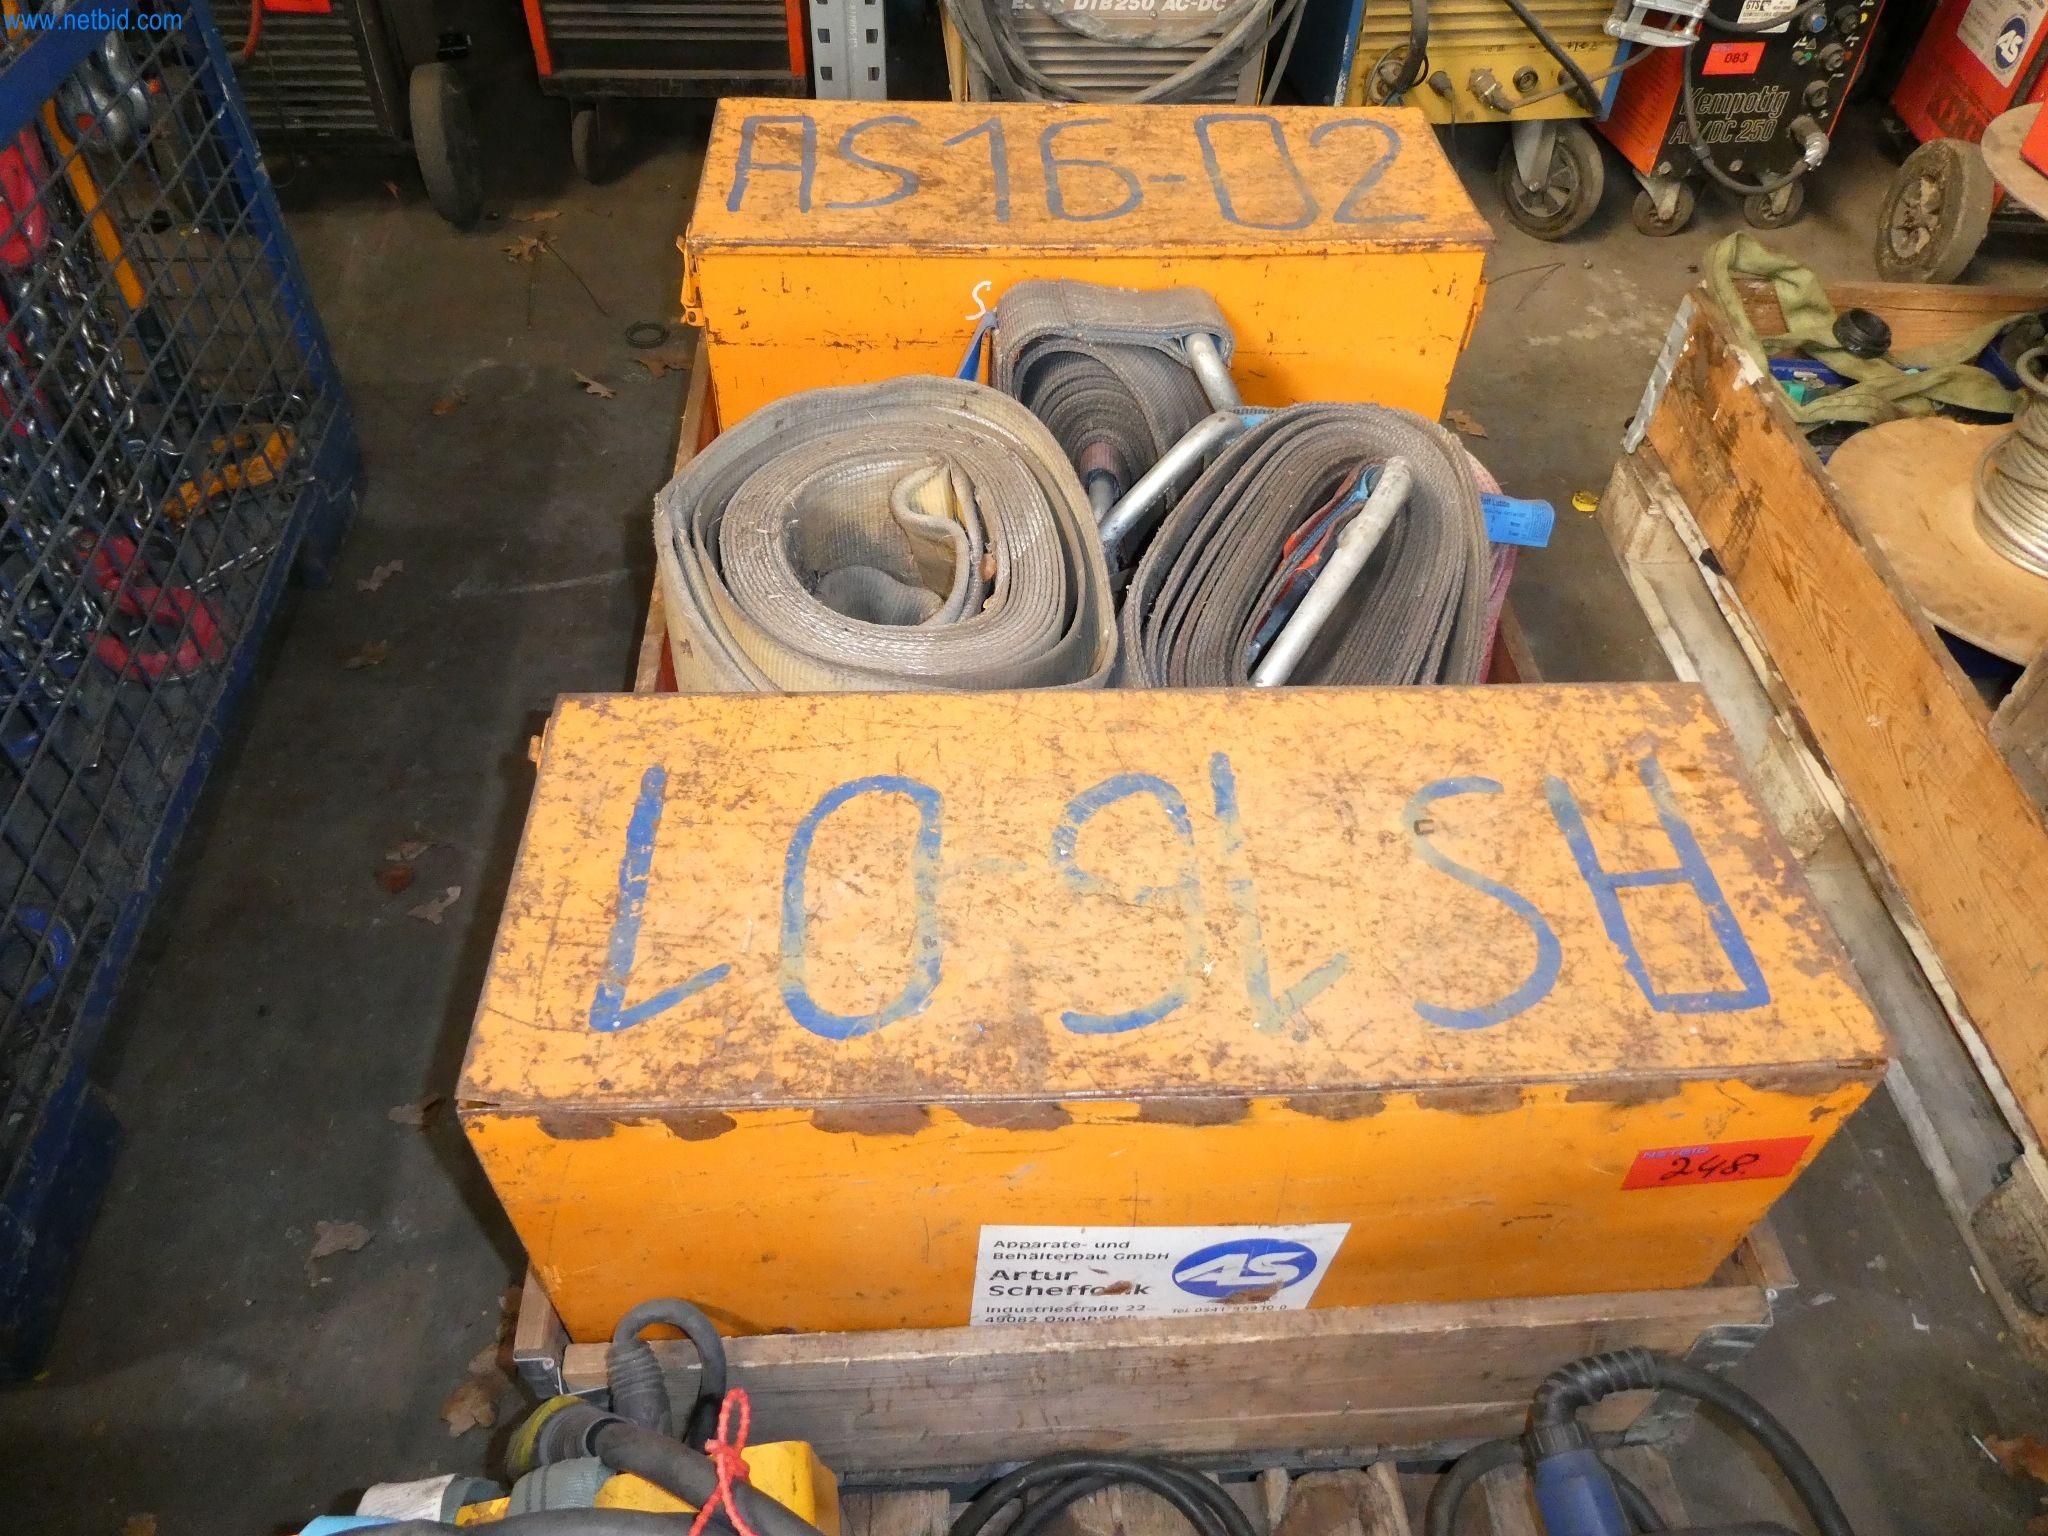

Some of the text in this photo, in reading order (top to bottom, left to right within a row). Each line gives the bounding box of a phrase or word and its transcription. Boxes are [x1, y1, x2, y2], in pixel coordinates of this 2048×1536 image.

[1724, 53, 1749, 64] 083
[1735, 119, 1778, 143] 250
[993, 1240, 1130, 1250] Apparate- und
[993, 1252, 1170, 1261] Behälterbau GmbH
[1175, 1252, 1308, 1286] AS
[989, 1269, 1079, 1281] Artur
[986, 1305, 1119, 1313] Industriestraße
